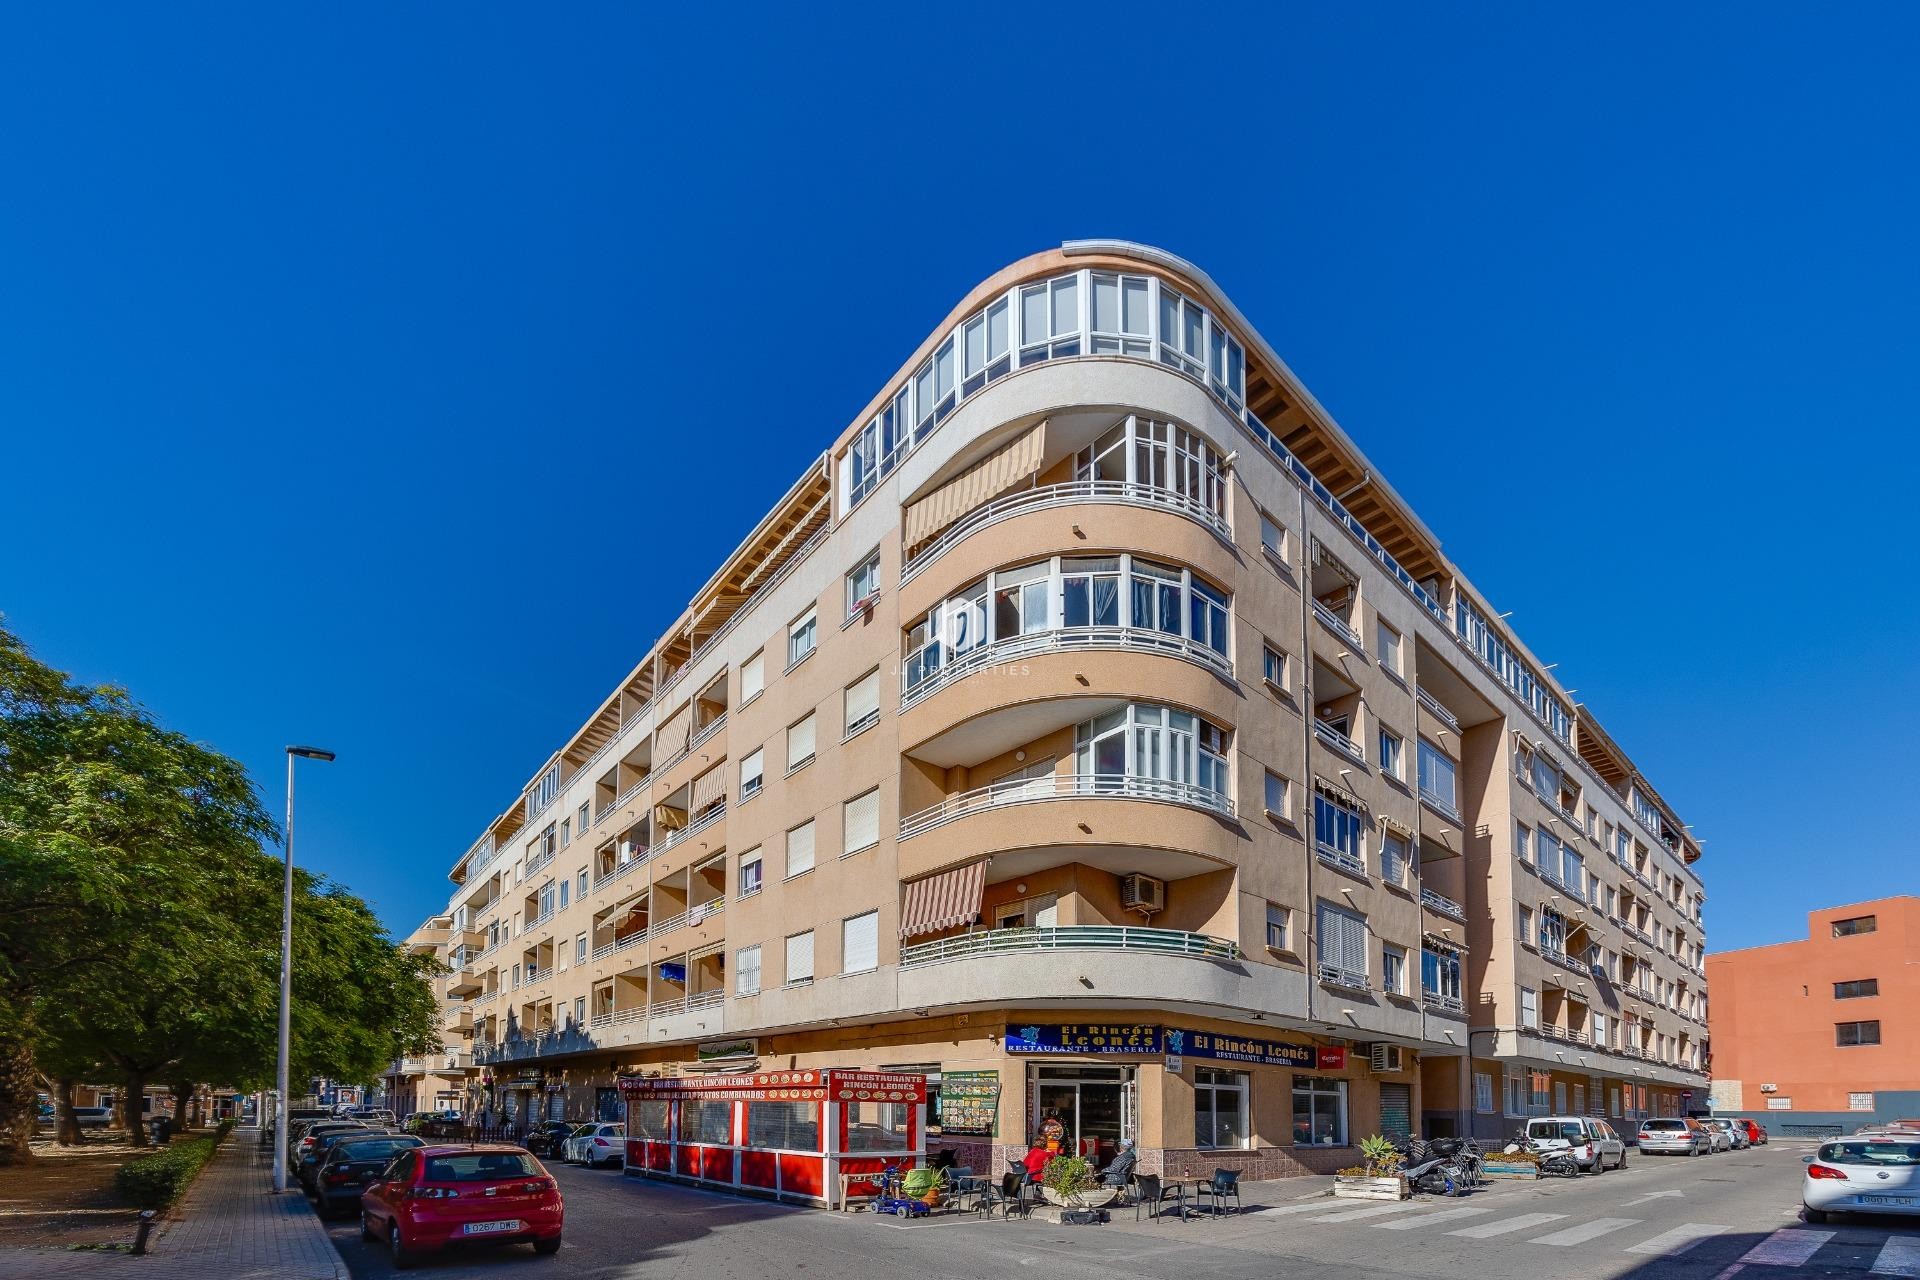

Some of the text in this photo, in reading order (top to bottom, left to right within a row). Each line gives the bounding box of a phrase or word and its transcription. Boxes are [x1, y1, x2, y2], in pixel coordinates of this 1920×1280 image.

[1061, 1026, 1153, 1035] El Rincón
[1194, 1035, 1209, 1049] El
[1214, 1037, 1263, 1055] Rincón
[1216, 1051, 1261, 1062] RESTAURANTE
[835, 1072, 922, 1083] BAR RESTAURANTE
[843, 1080, 915, 1091] RINCÓN LEONÉS
[720, 1090, 766, 1099] COMBINADOS
